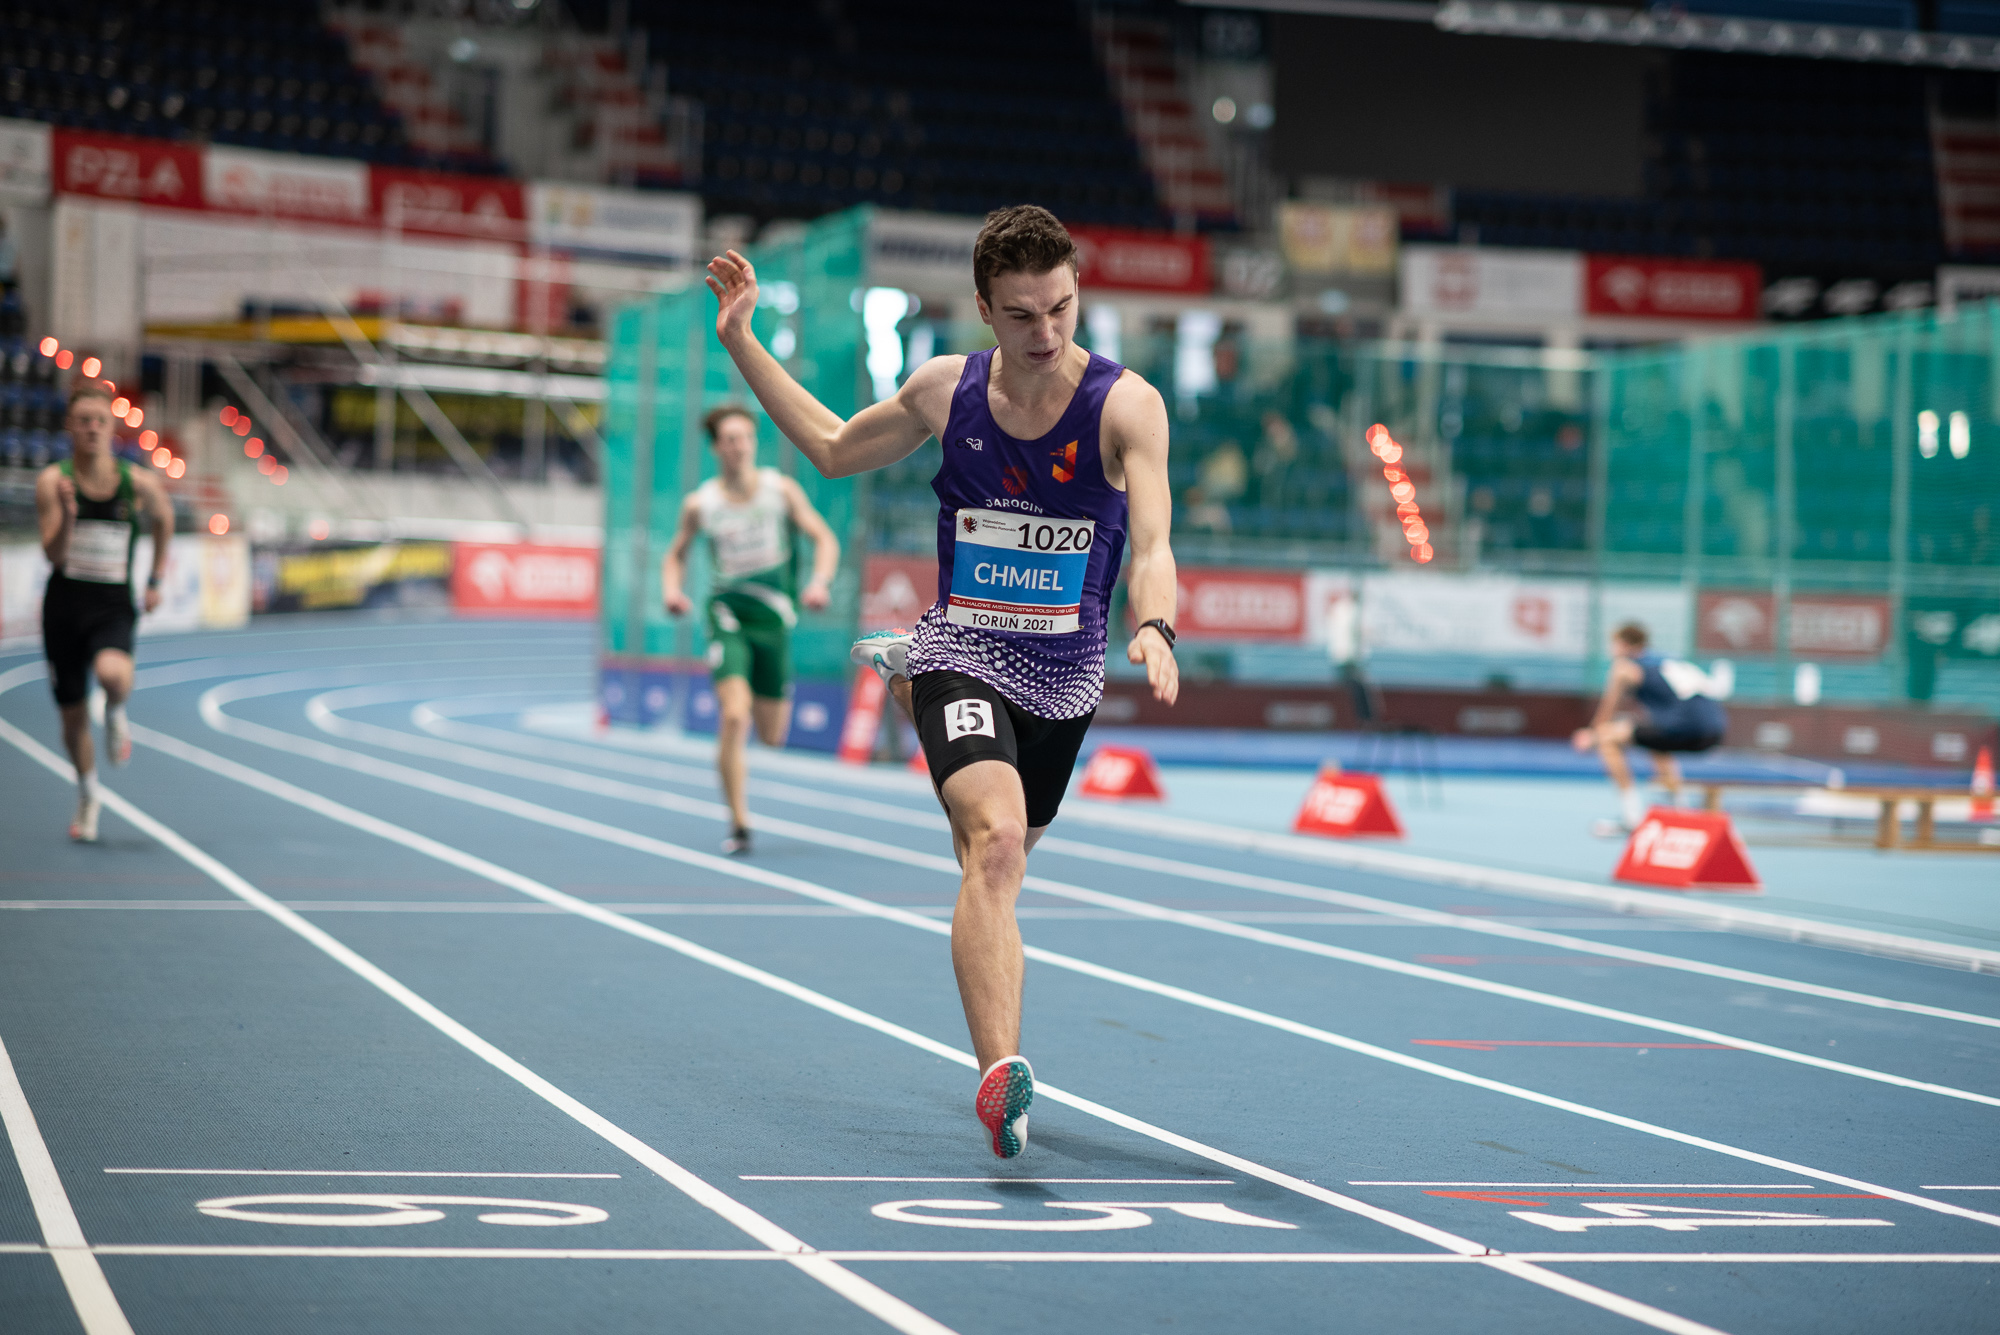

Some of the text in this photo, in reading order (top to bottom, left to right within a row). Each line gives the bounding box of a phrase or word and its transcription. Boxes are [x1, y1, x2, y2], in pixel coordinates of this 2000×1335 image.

[66, 146, 184, 198] PZLA
[985, 498, 1043, 514] JAROCIN
[1018, 523, 1092, 551] 1020
[974, 562, 1063, 591] CHMIEL
[967, 601, 991, 609] HALOWE
[992, 604, 1034, 612] MISTRZOSTWA
[972, 613, 1054, 631] TORUŃ 2021
[957, 703, 984, 732] 5
[196, 1194, 609, 1226] 6
[870, 1199, 1300, 1231] 5
[1507, 1203, 1896, 1232] 4
